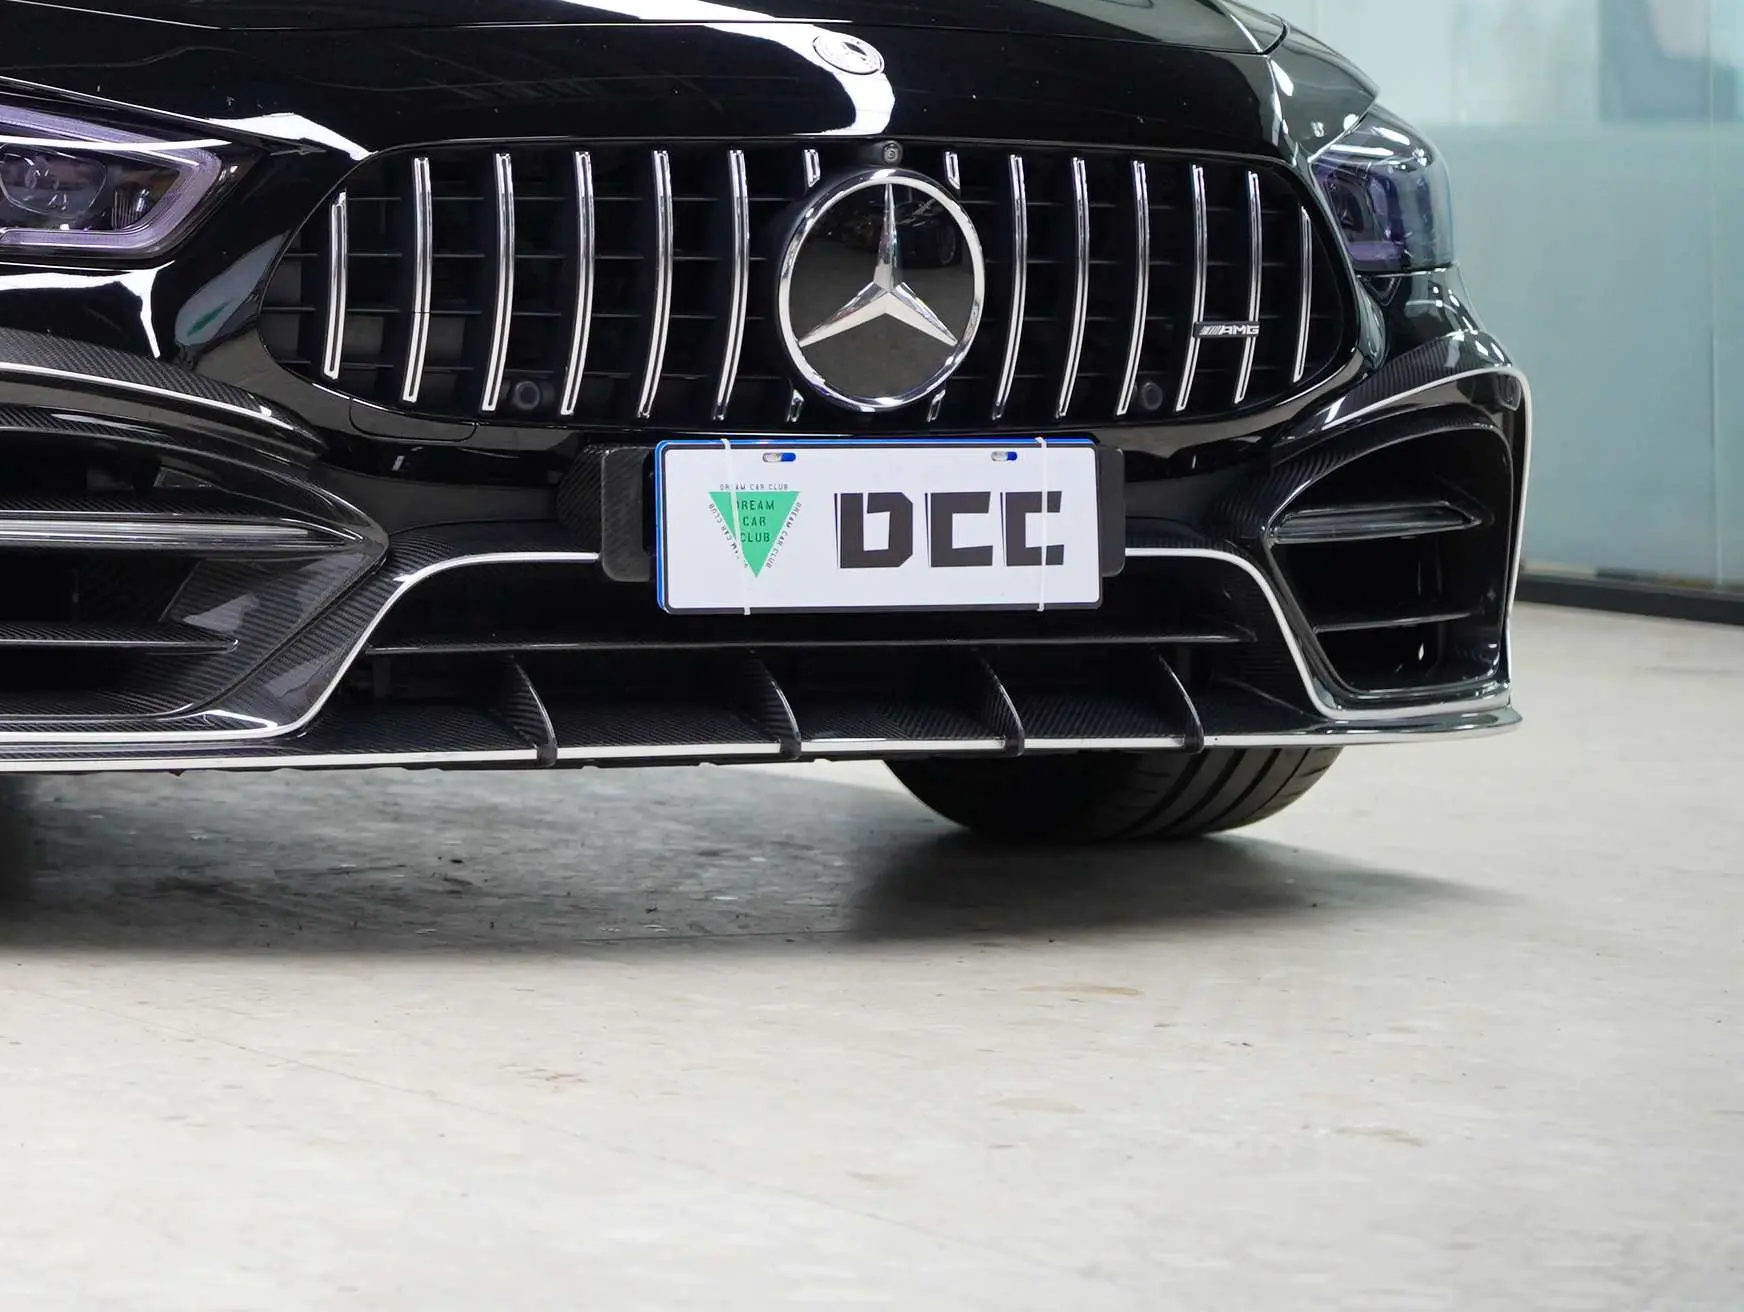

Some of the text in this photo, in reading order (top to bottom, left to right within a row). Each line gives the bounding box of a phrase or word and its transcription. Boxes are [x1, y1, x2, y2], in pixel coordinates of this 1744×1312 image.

[1218, 324, 1260, 336] AMG
[743, 516, 767, 526] CAR
[834, 491, 1064, 569] DCC
[740, 532, 771, 543] CLUB
